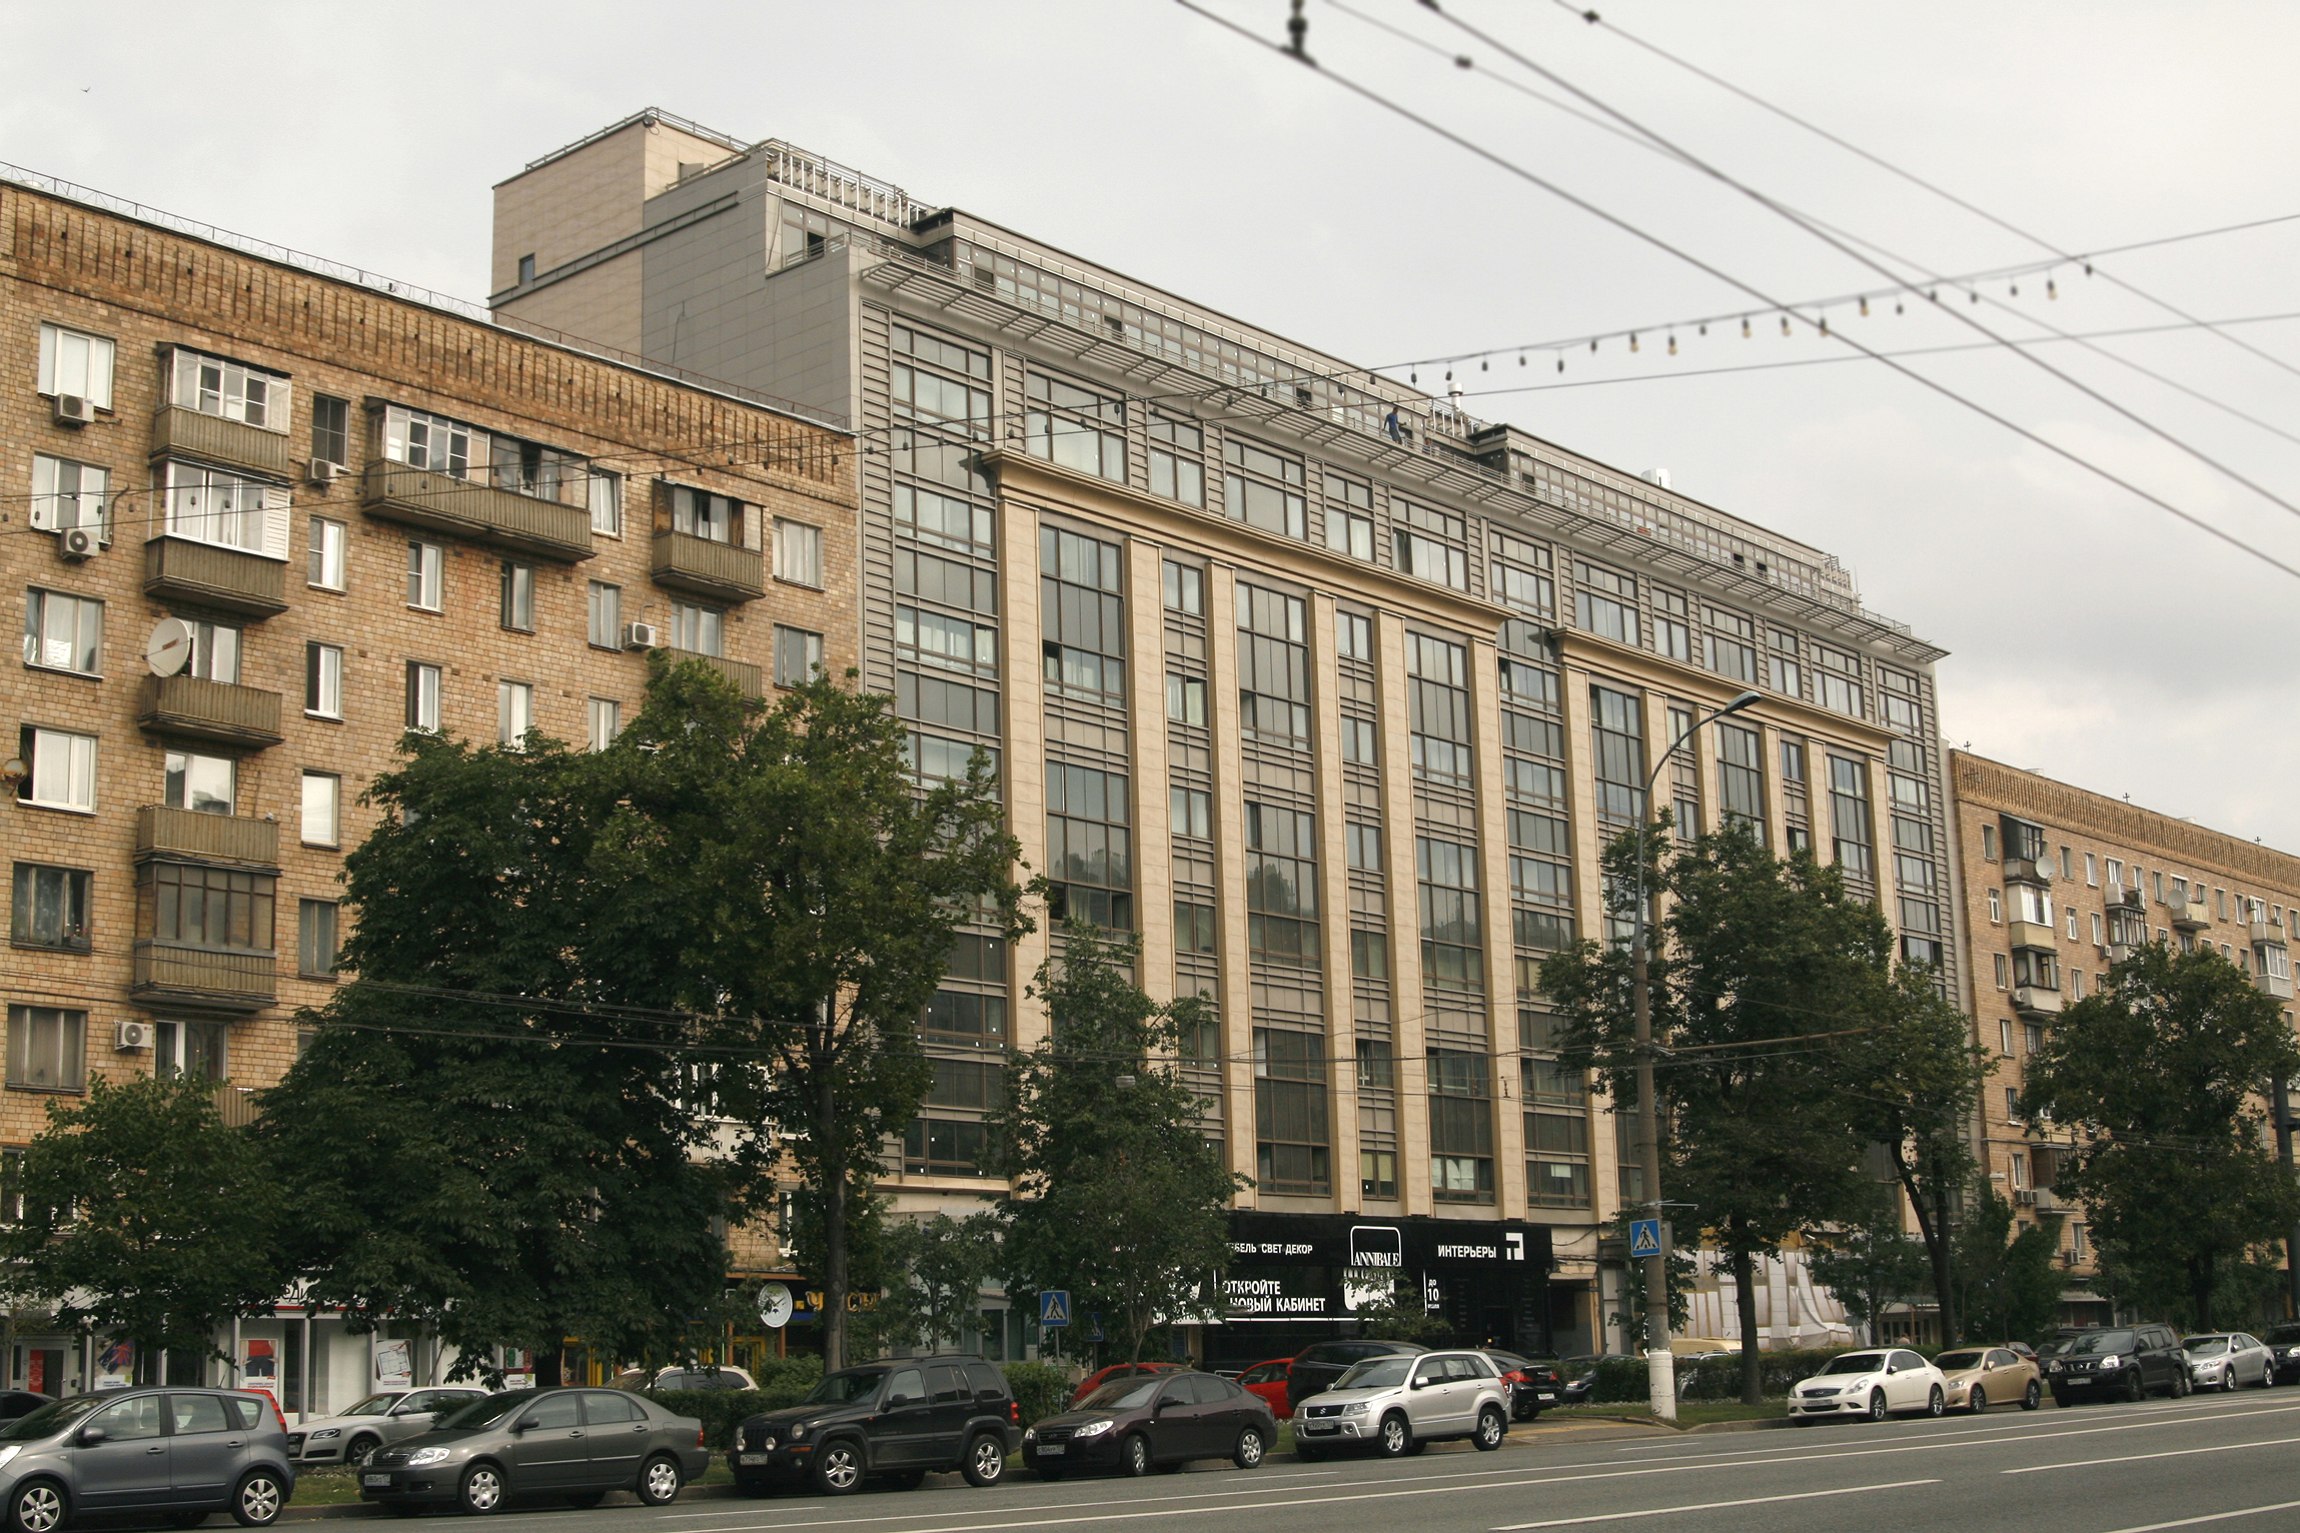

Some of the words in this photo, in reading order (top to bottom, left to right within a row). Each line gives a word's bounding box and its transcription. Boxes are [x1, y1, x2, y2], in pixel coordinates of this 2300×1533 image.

[1221, 1242, 1257, 1253] БЕЛЬ
[1261, 1243, 1283, 1254] СВЕТ
[1285, 1244, 1313, 1256] ДЕКОР
[1437, 1245, 1497, 1258] ИНТЕРЬЕРЫ
[1353, 1251, 1400, 1267] ANNIBALE
[1222, 1279, 1281, 1295] ОТКРОЙТЕ
[1427, 1288, 1440, 1302] 10
[1276, 1297, 1326, 1312] КАБИНЕТ
